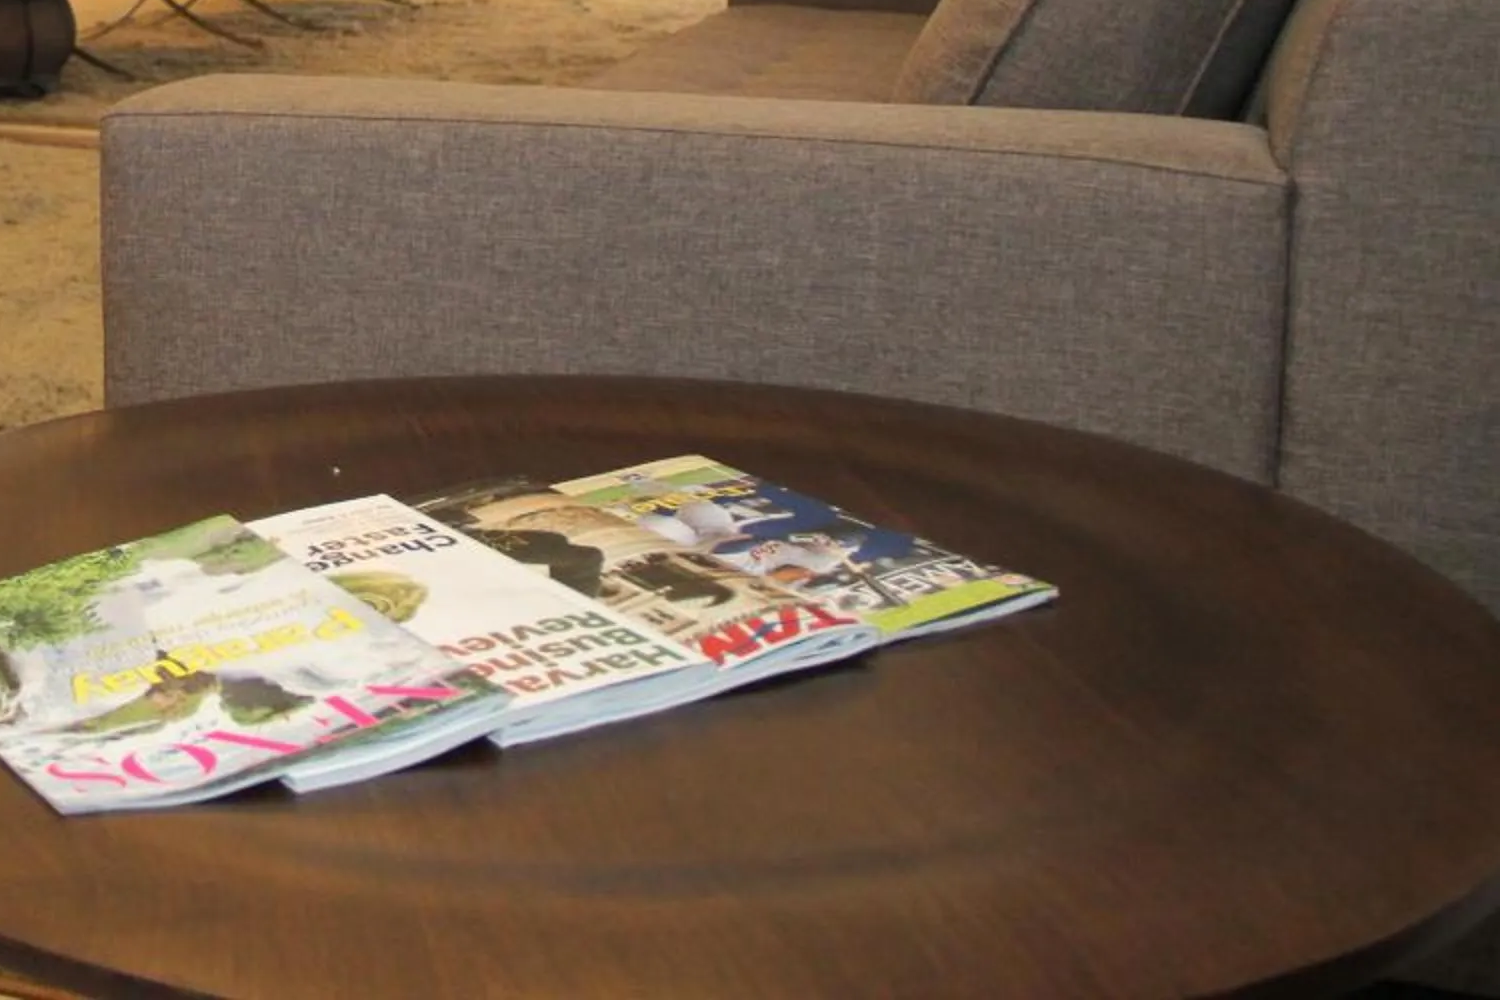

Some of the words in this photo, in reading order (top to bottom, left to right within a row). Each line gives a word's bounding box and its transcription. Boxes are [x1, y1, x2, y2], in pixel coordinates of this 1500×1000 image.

[304, 534, 459, 573] Change
[307, 523, 438, 558] Faster
[70, 606, 366, 705] Paraguay
[465, 626, 651, 679] Busine
[503, 642, 688, 695] Harva
